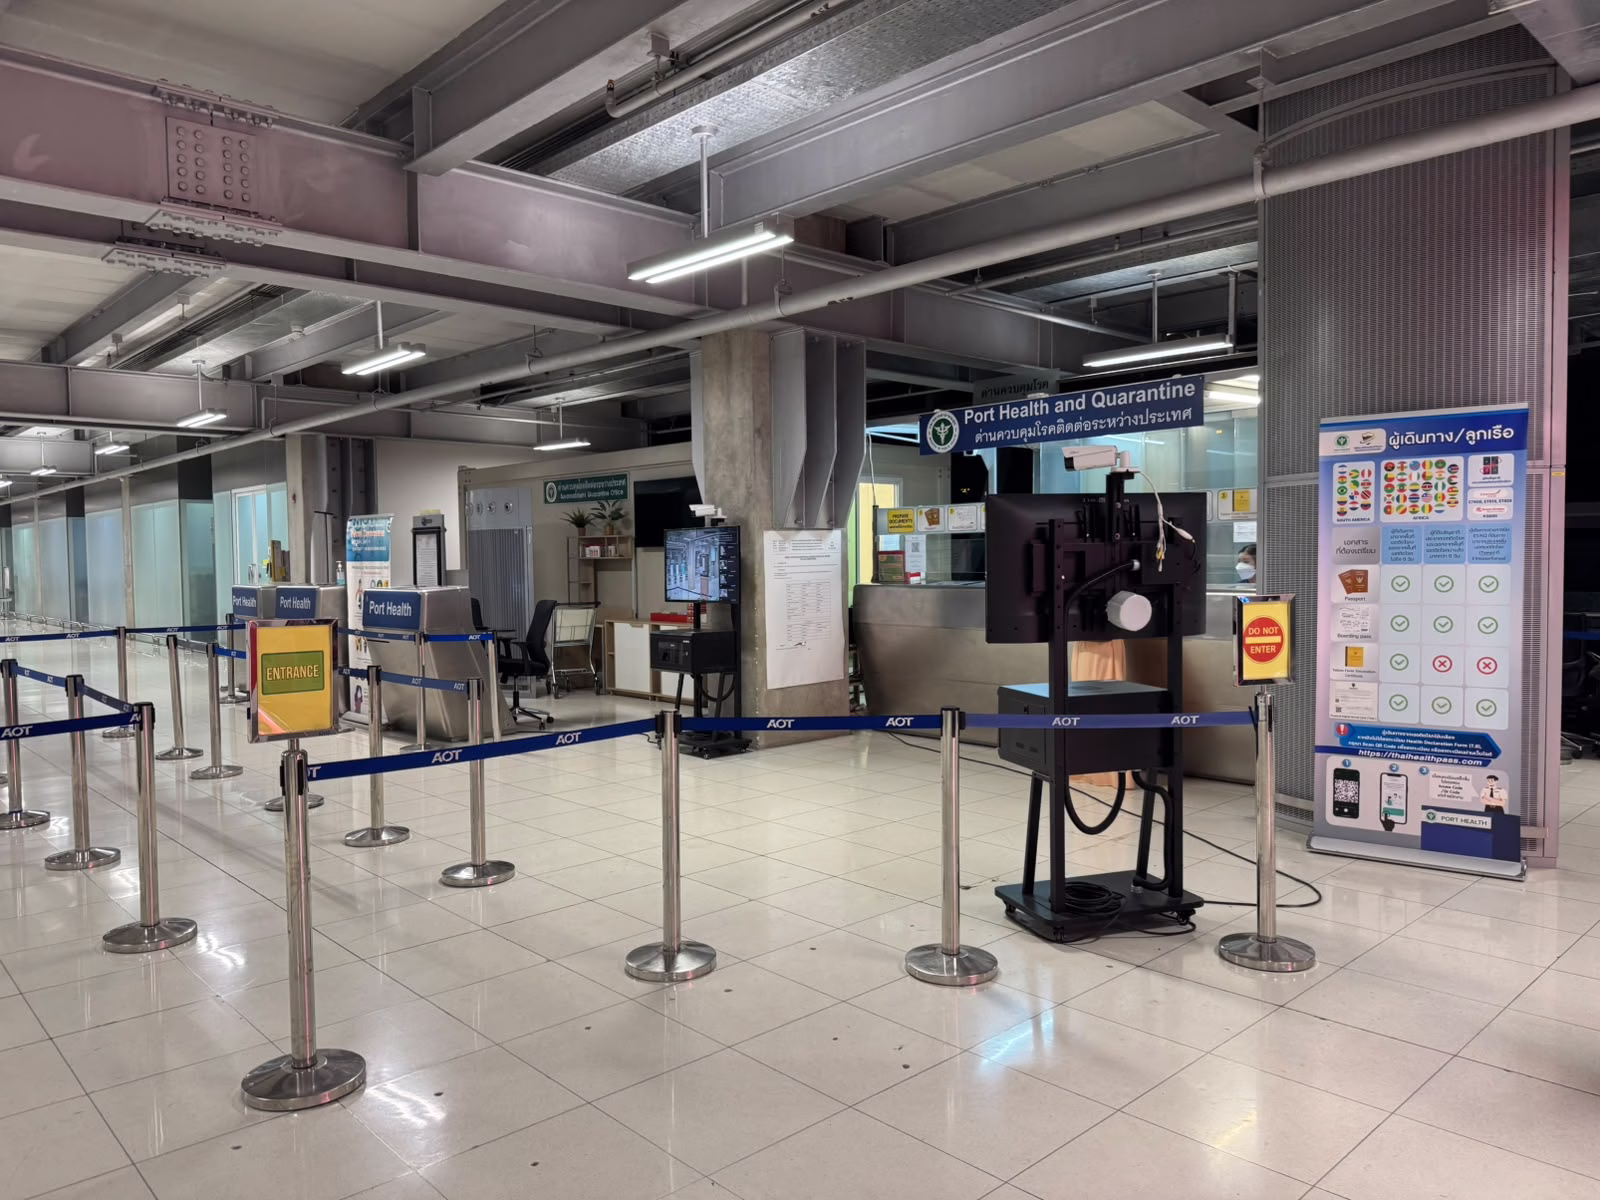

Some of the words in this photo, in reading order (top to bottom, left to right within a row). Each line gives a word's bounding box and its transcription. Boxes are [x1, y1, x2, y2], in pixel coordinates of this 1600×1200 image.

[964, 408, 995, 424] Port
[1000, 399, 1049, 420] Health
[1054, 394, 1086, 414] and
[1091, 380, 1196, 409] Quarantine
[975, 407, 1192, 444] ด่านควบคุมโรคติดต่อระหว่างประเทศ
[232, 596, 241, 606] Port
[242, 596, 256, 608] Health
[280, 596, 291, 609] Port
[292, 596, 311, 609] Health
[369, 600, 385, 616] Port
[386, 603, 412, 617] Health
[1248, 627, 1260, 635] DO
[1262, 626, 1278, 635] NOT
[1250, 646, 1276, 654] ENTER
[266, 664, 319, 680] ENTRANCE
[766, 719, 795, 729] AOT
[886, 717, 914, 728] AOT
[1052, 717, 1080, 726] AOT
[1171, 715, 1200, 725] AOT
[1, 726, 33, 738] AOT
[556, 732, 581, 746] AOT
[431, 750, 462, 764] AOT
[1358, 750, 1482, 766] https://thaihealthpass.com
[1461, 818, 1488, 826] HEALTH
